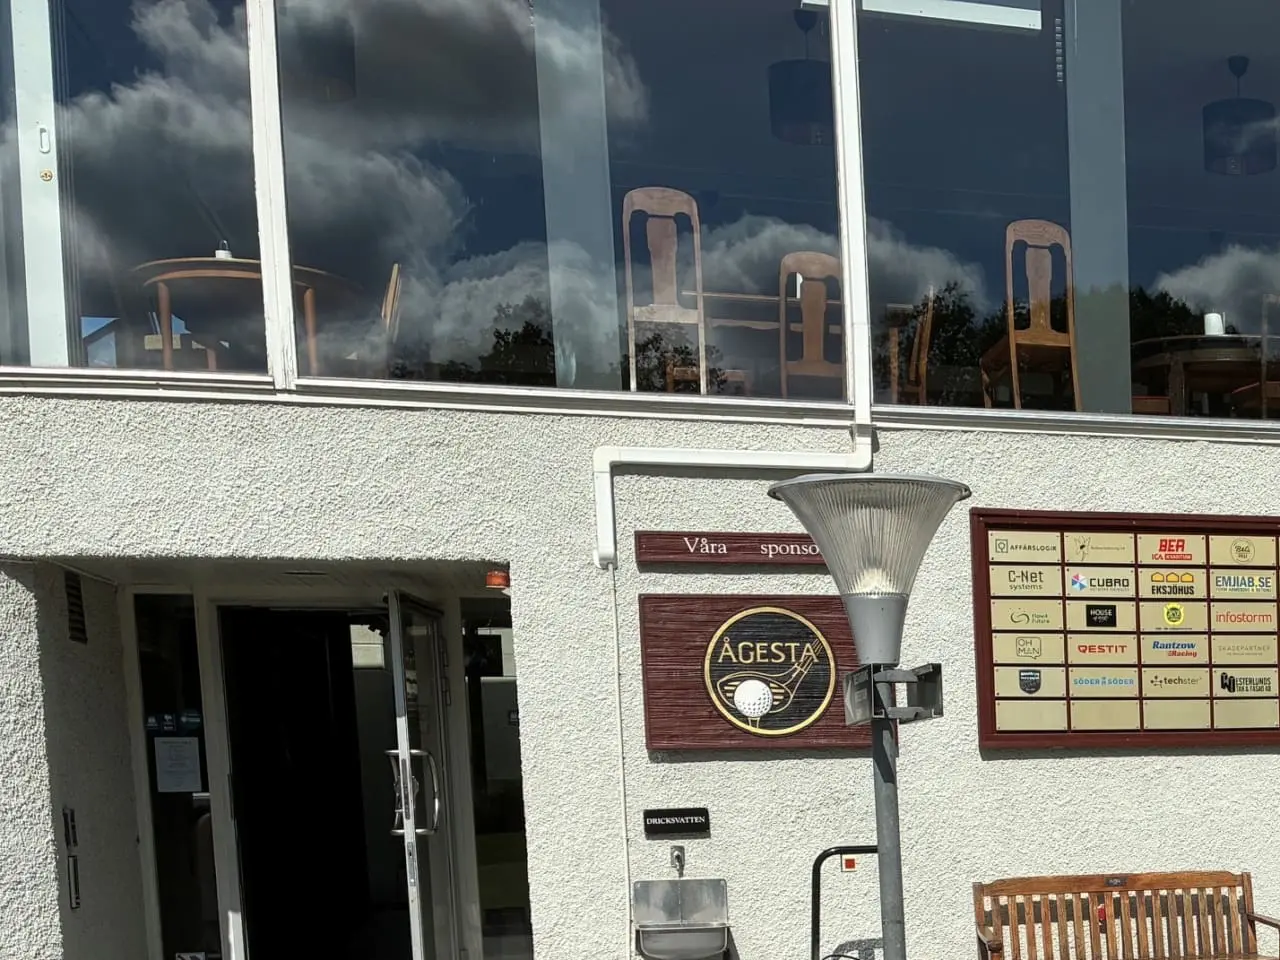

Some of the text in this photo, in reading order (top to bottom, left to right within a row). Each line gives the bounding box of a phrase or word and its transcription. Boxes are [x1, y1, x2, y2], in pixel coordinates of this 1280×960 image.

[683, 536, 820, 559] Våra sponso
[1158, 538, 1185, 552] BEA
[1008, 569, 1045, 583] C-Net
[1089, 577, 1130, 588] CUBRO
[1151, 584, 1195, 595] EKSJÖHUS
[1090, 608, 1113, 617] HOUSE
[1215, 610, 1273, 623] infostorm
[1018, 638, 1033, 647] OH
[1152, 640, 1197, 650] Rantzow
[717, 637, 820, 664] ÅGESTA
[1077, 644, 1127, 654] QESTIT
[1073, 677, 1100, 685] SÖDER
[1163, 675, 1199, 685] techster
[645, 815, 706, 826] DRICKSVATTEN
